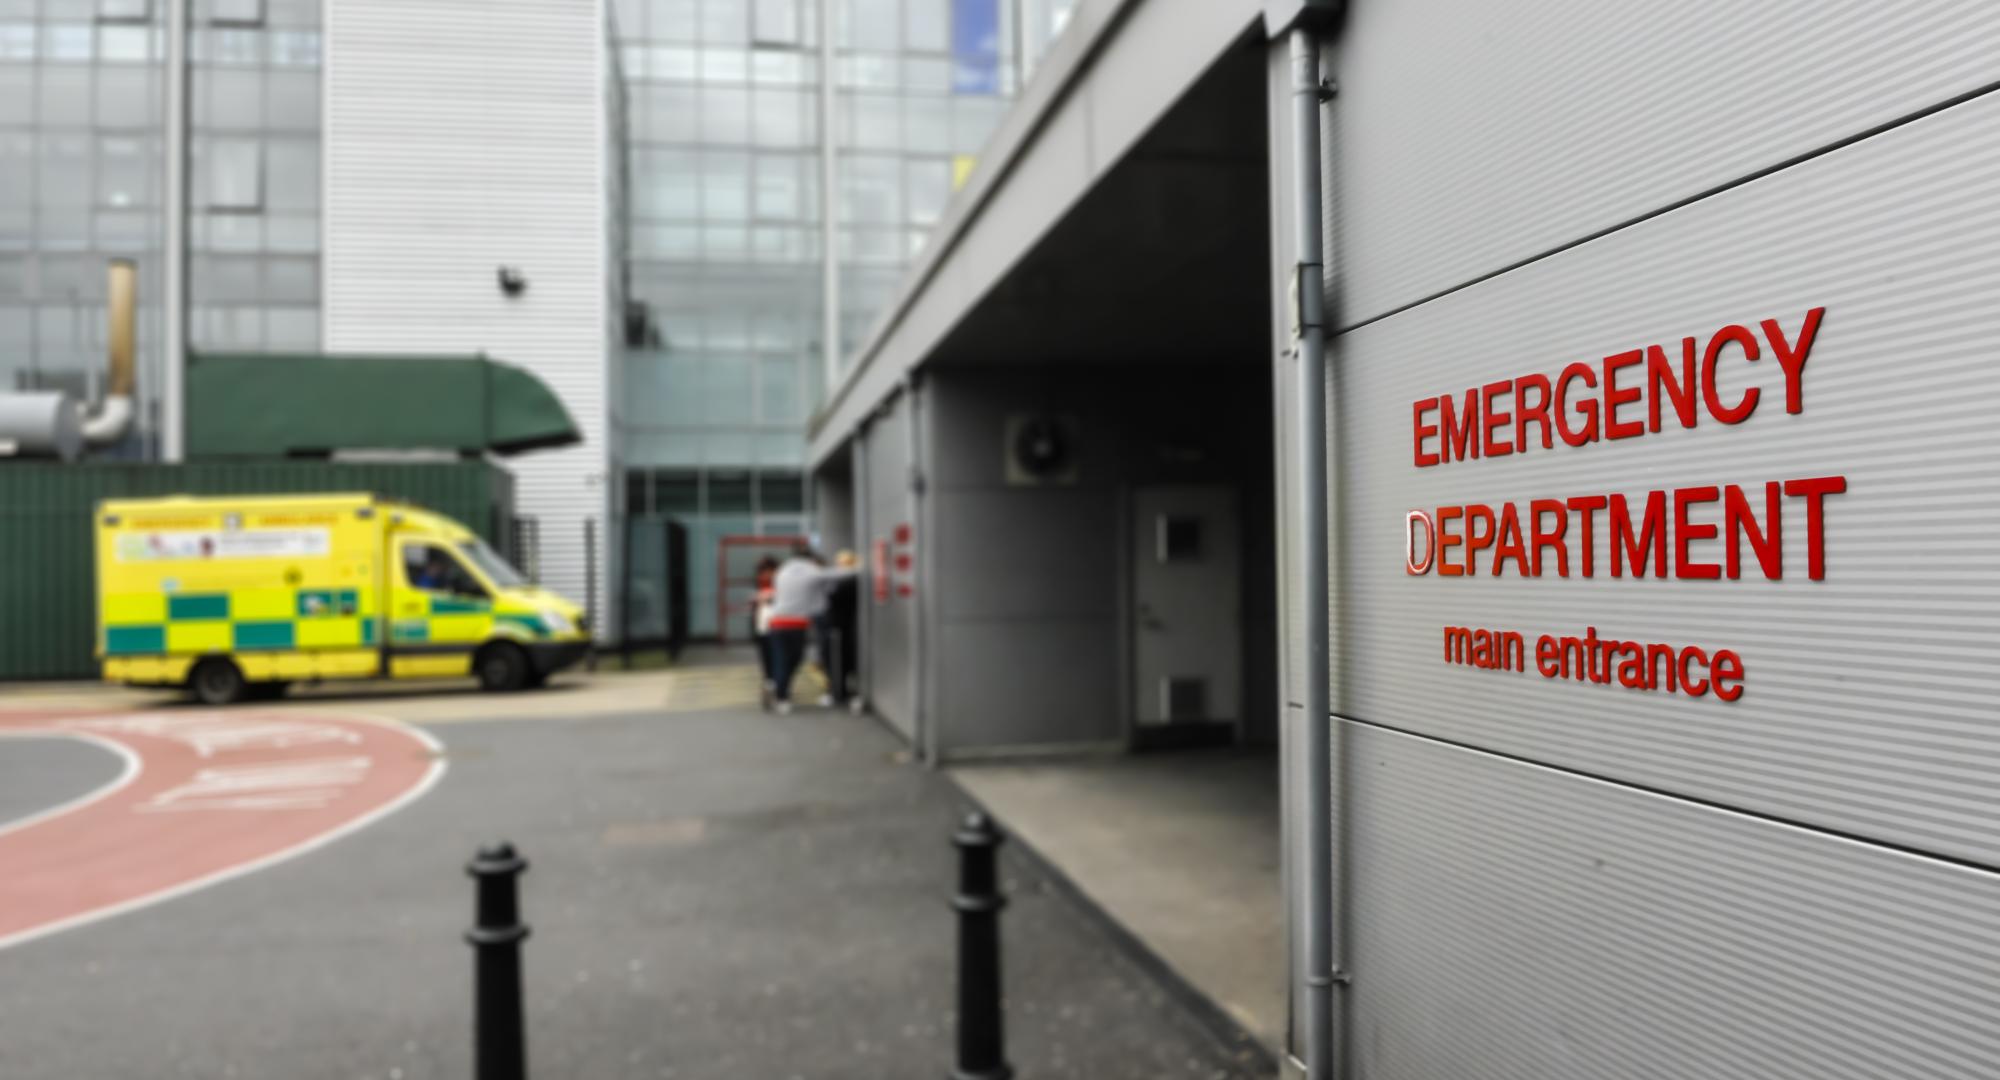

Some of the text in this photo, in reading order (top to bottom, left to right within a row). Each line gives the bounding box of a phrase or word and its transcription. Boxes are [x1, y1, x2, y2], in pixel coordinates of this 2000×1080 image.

[1413, 306, 1826, 468] EMERGENCY
[1406, 475, 1847, 582] DEPARTMENT
[1443, 626, 1745, 702] main entrance
